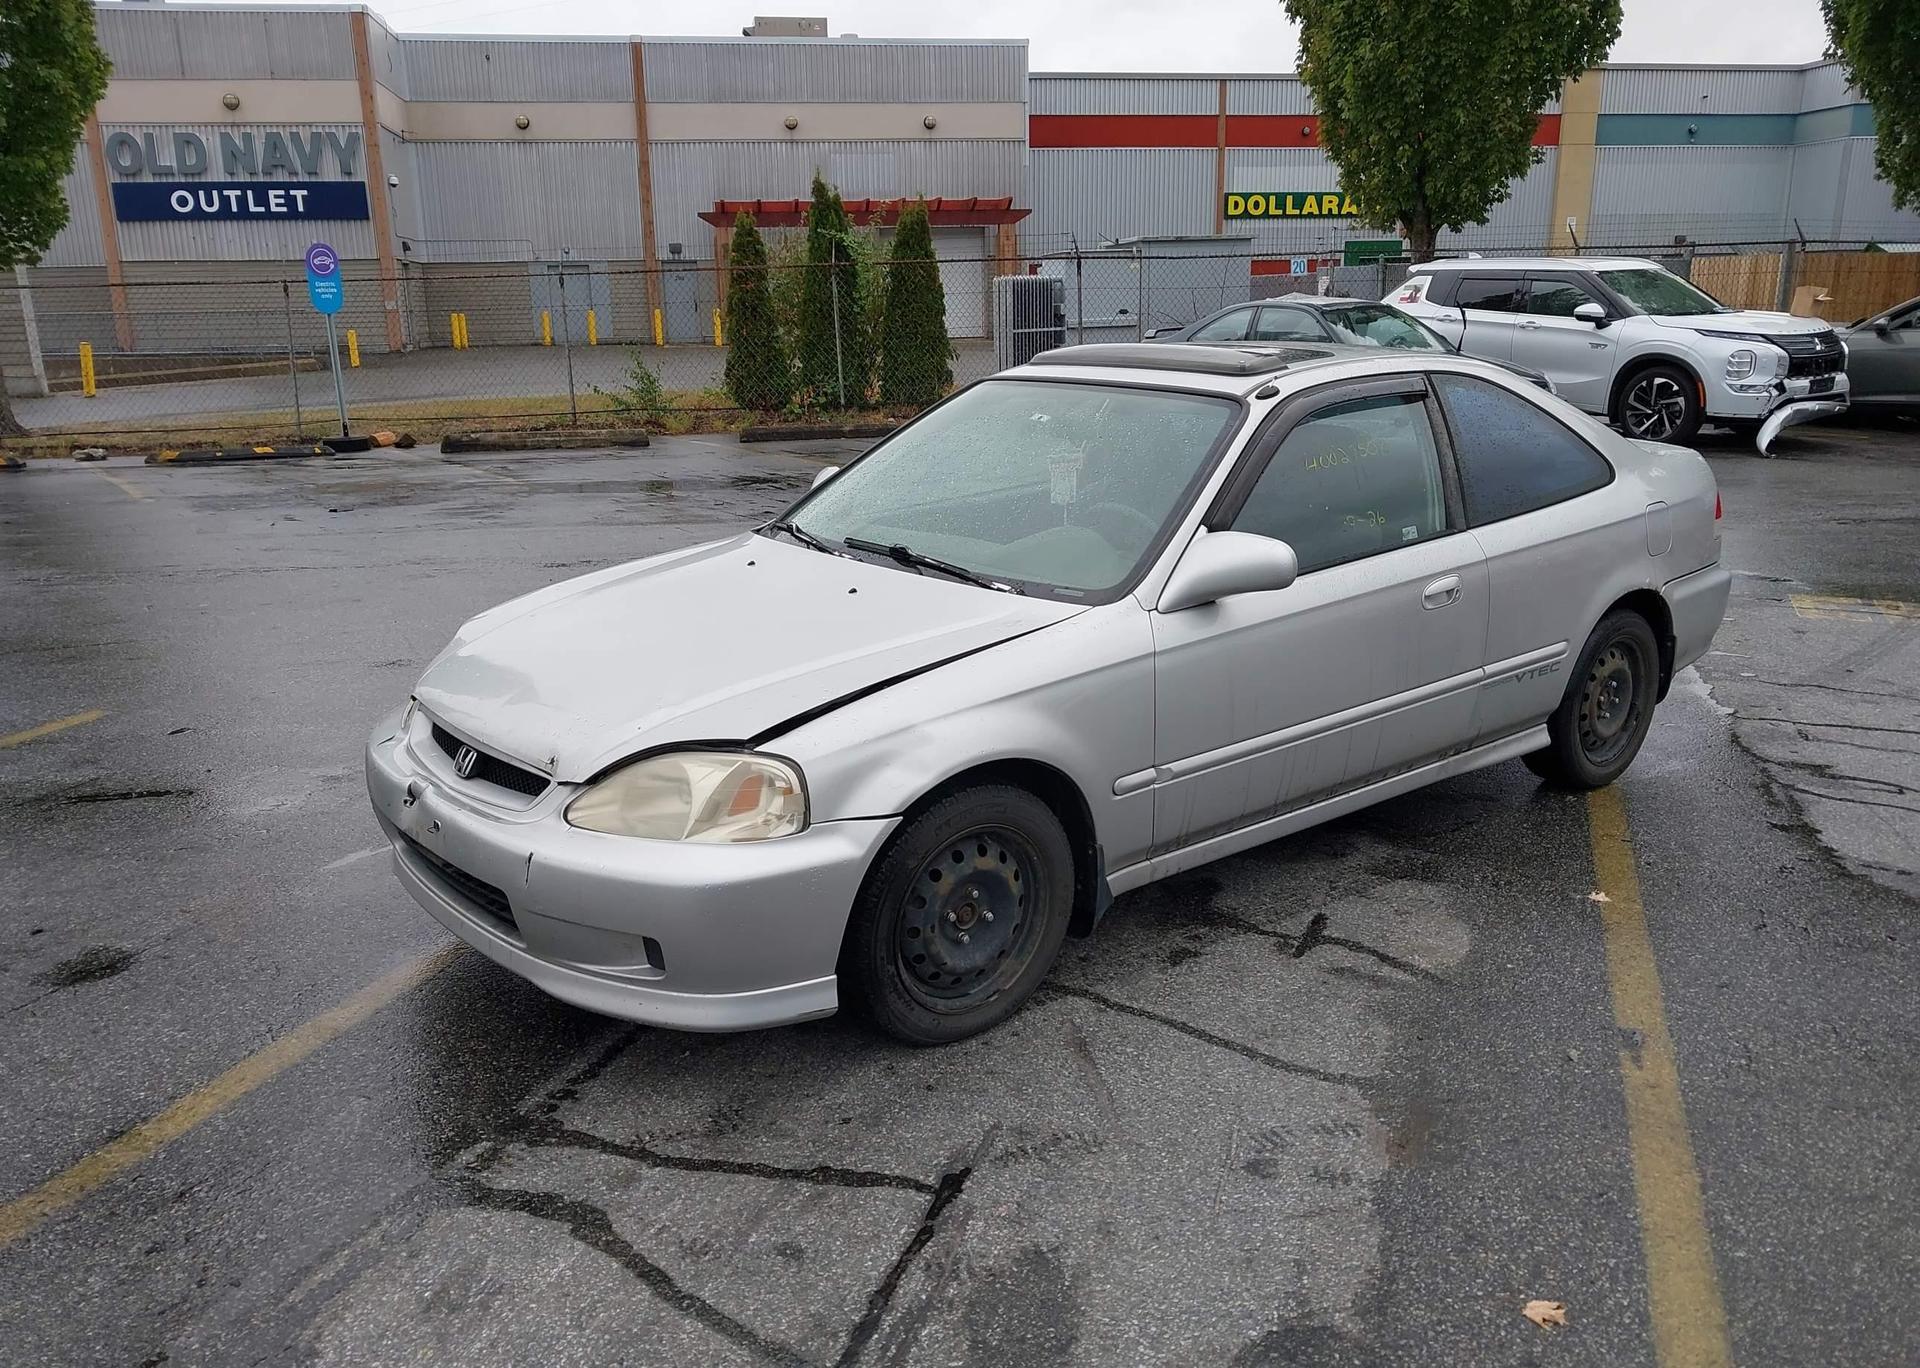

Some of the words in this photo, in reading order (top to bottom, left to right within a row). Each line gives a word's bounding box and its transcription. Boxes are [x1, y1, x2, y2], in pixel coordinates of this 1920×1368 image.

[106, 131, 208, 176] OLD
[220, 131, 361, 176] NAVY
[170, 189, 309, 213] OUTLET
[1227, 194, 1361, 216] DOLLARA
[1292, 260, 1306, 274] 20
[1514, 661, 1561, 683] VTEC
